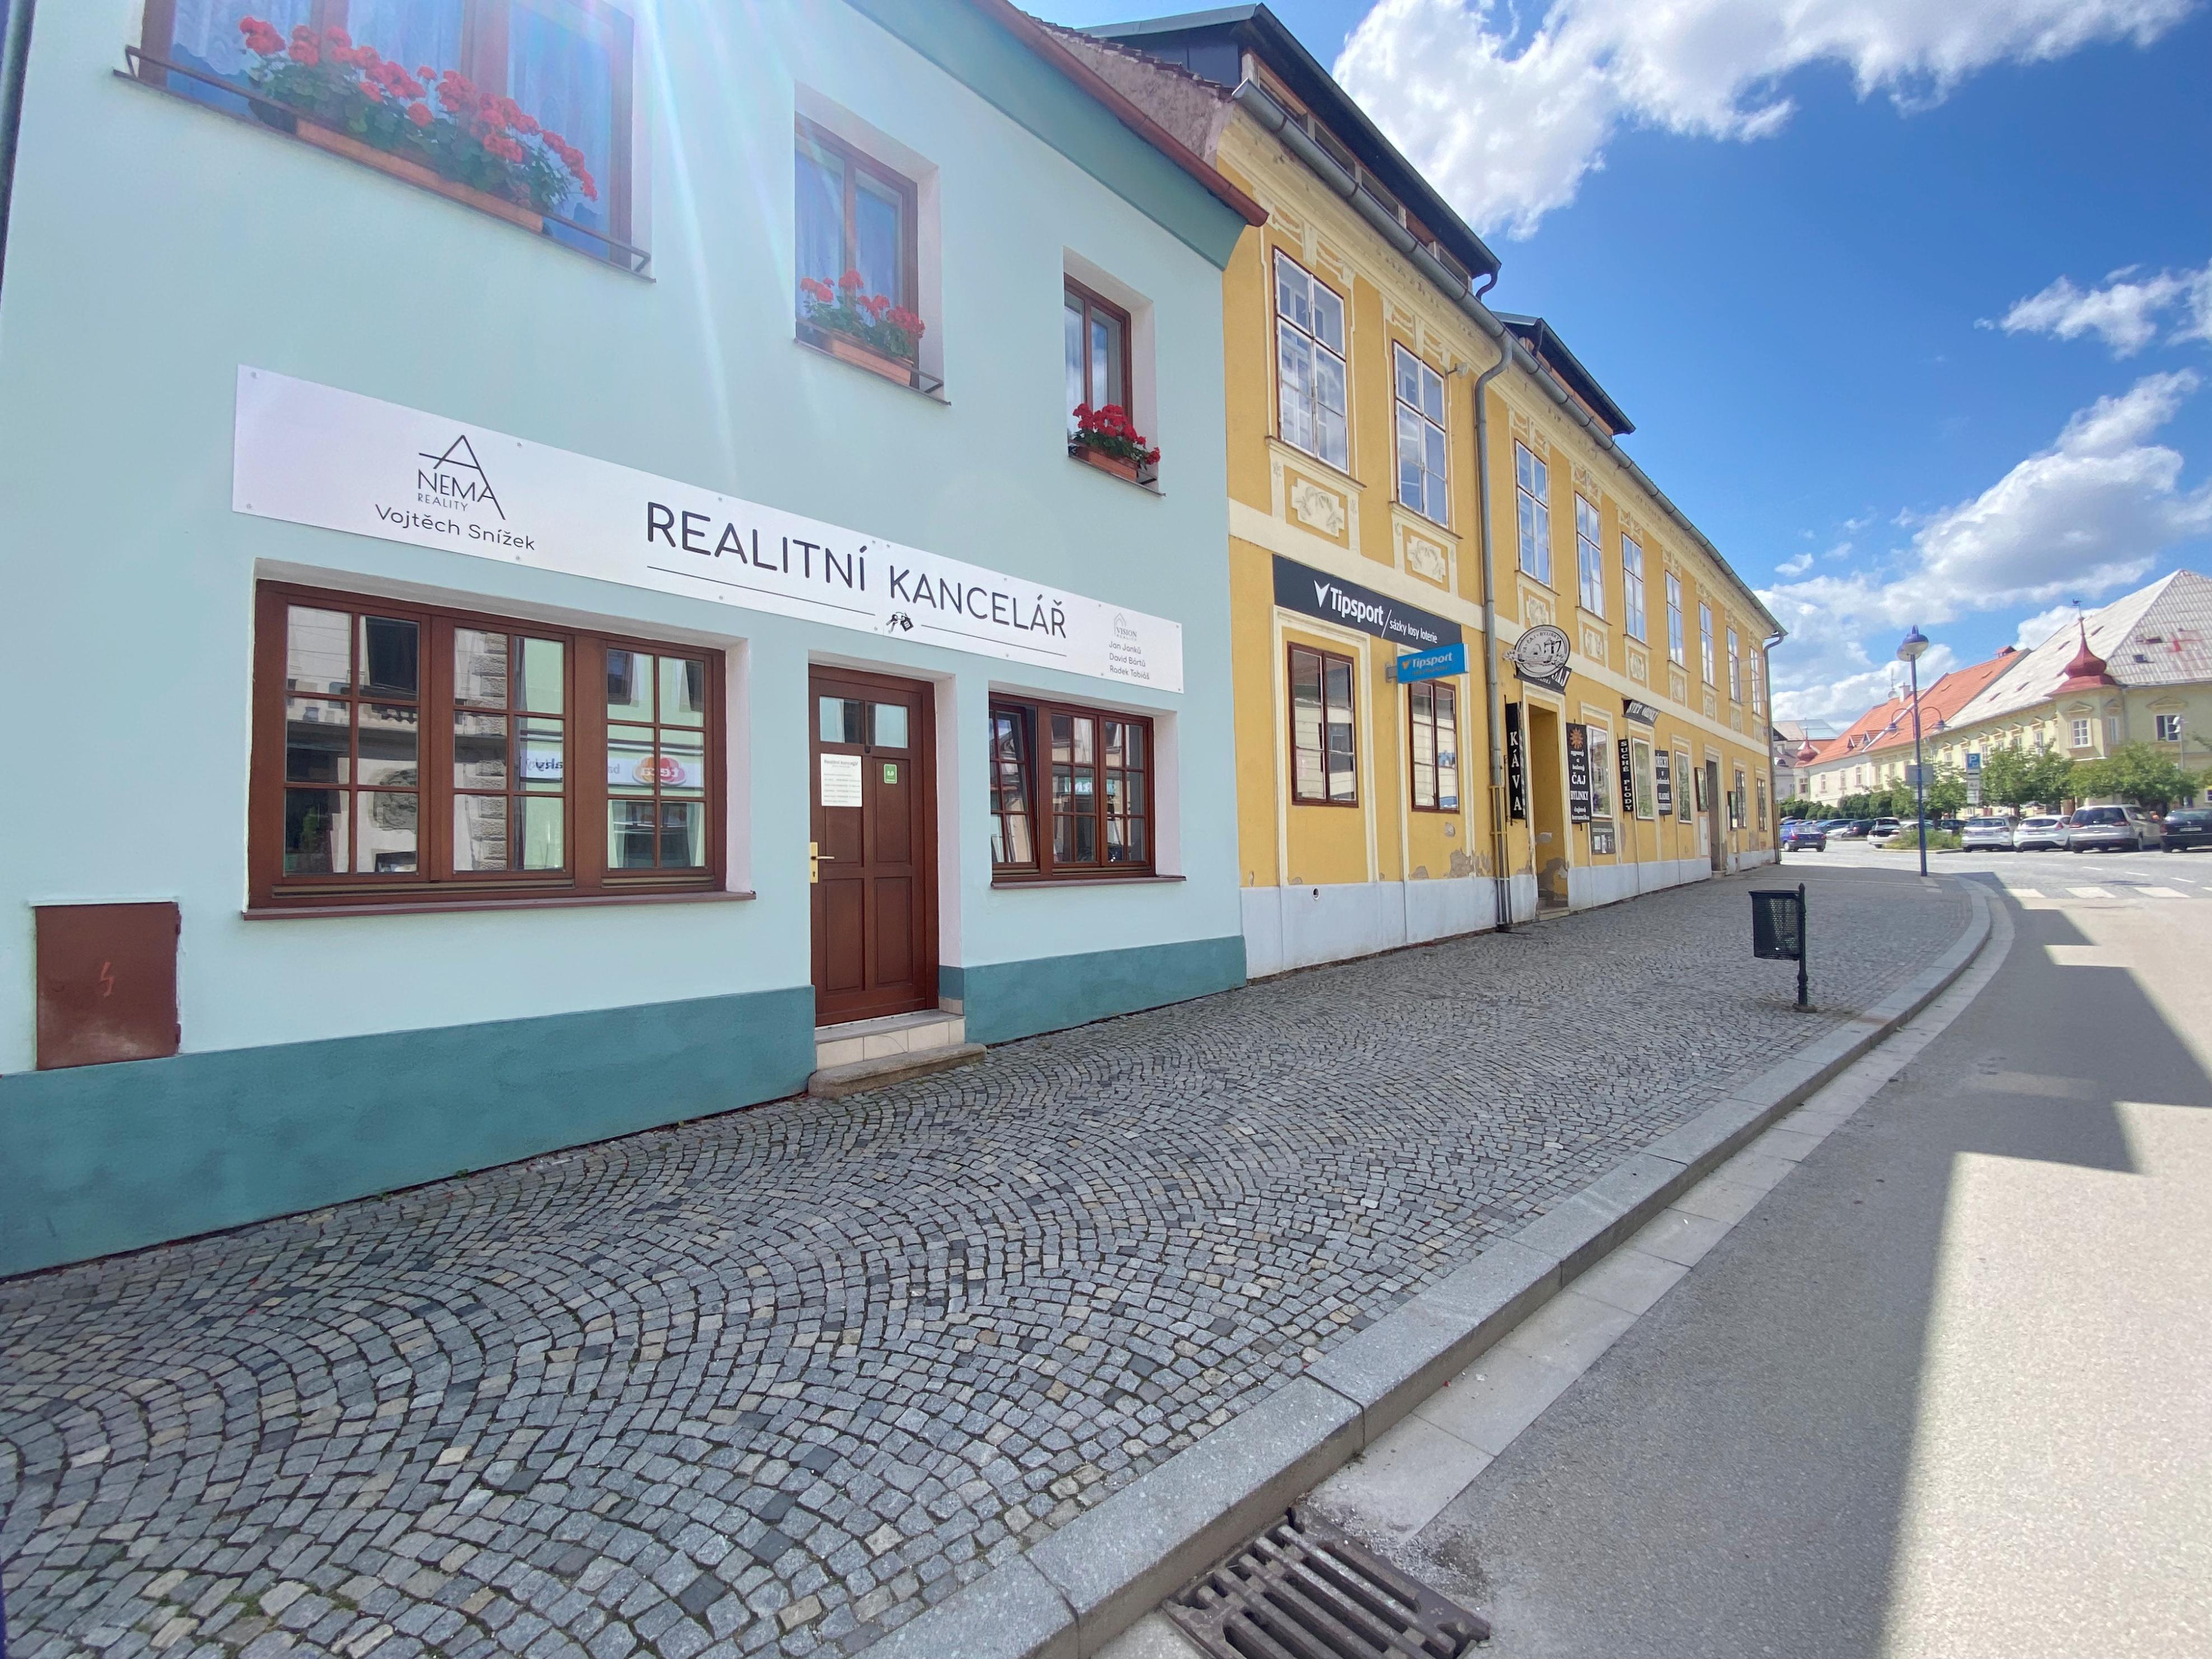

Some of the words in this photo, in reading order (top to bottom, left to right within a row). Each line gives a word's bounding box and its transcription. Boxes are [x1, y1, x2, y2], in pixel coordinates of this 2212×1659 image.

[418, 469, 498, 503] NEMA
[418, 493, 468, 512] REALITY
[375, 504, 460, 536] Vojtěch
[468, 524, 535, 550] Snížek
[647, 502, 867, 591] REALITNÍ
[890, 565, 1066, 639] KANCELÁŘ
[1330, 587, 1384, 626] Tipsport
[1390, 619, 1407, 636] sázky
[1408, 623, 1420, 640] losy
[1420, 627, 1438, 644] loterie
[1116, 627, 1137, 638] VISION
[1109, 641, 1121, 650] Jan
[1109, 653, 1127, 663] David
[1413, 652, 1452, 669] Tipsport
[1110, 665, 1129, 676] Radek
[1130, 669, 1150, 679] Tobiáš
[1510, 732, 1522, 810] KÁVA
[1572, 772, 1586, 785] ČAJ
[1570, 790, 1589, 800] BYLINKY
[1624, 779, 1632, 810] PLODY
